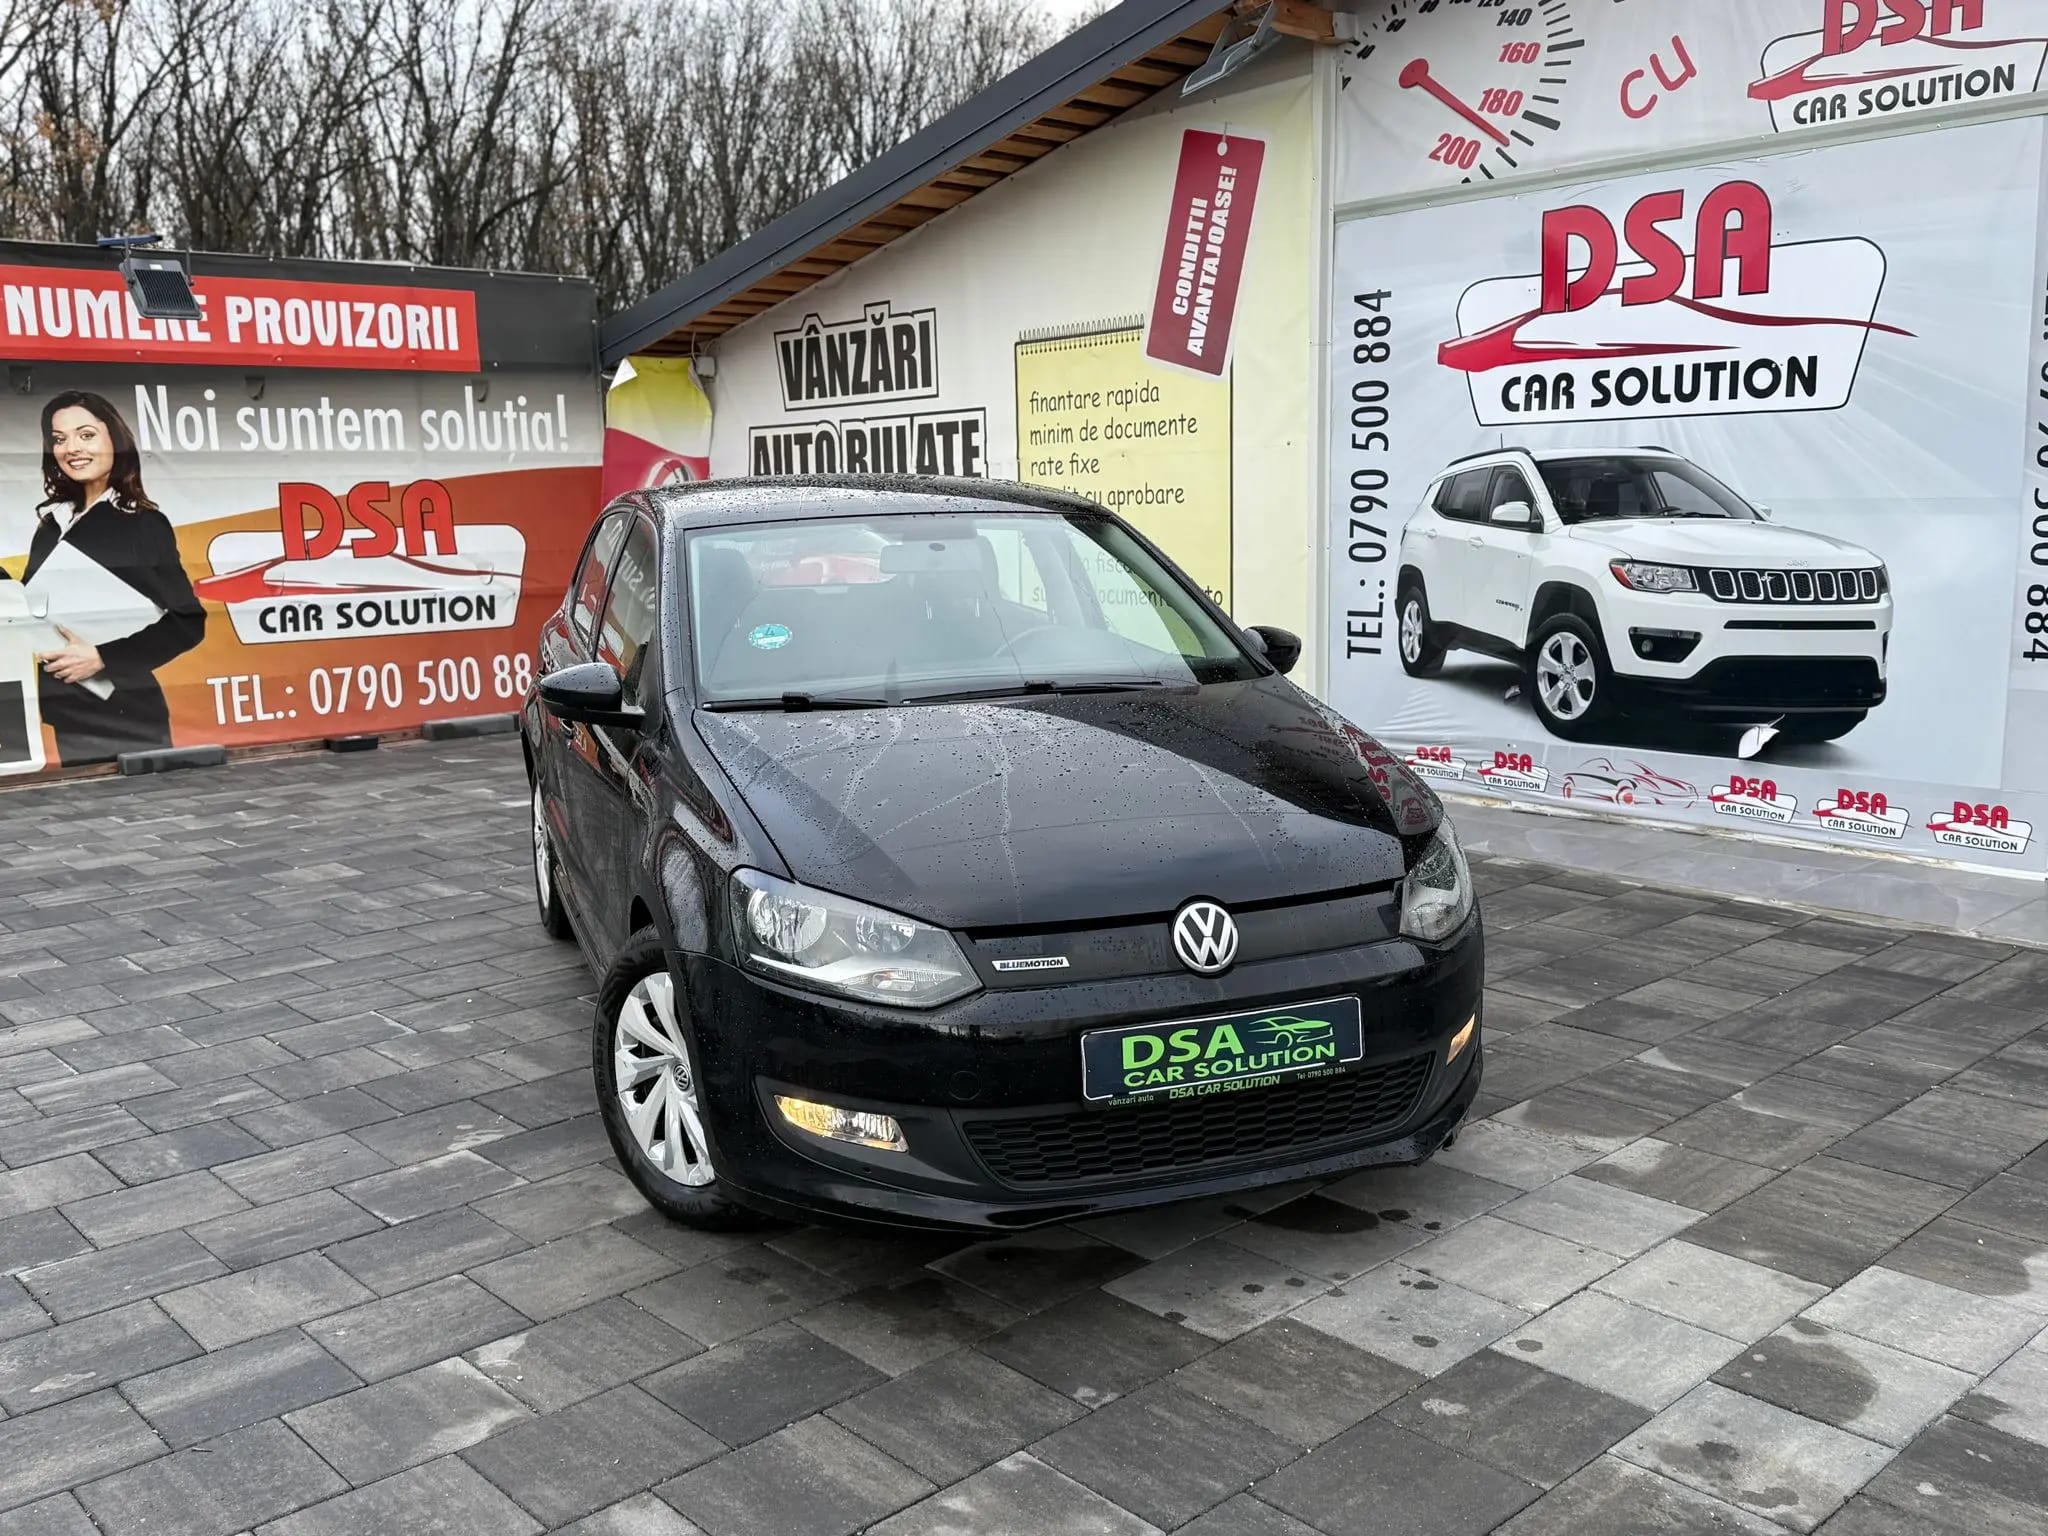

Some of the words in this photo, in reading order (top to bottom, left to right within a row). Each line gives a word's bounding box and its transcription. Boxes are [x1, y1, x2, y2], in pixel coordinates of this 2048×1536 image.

[1496, 8, 1533, 27] 140
[1498, 42, 1541, 64] 160
[1620, 35, 1698, 119] cu
[1793, 94, 1846, 125] CAR
[1858, 64, 2015, 116] SOLUTION
[1477, 88, 1524, 116] 180
[1428, 133, 1481, 170] 200
[1172, 197, 1208, 316] CONDITII
[1187, 165, 1237, 357] AVANTAJOASE!
[1541, 180, 1772, 314] DSA
[225, 295, 459, 352] PROVIZORII
[1354, 289, 1392, 364] 884
[780, 312, 932, 400] VÂNZĂRI
[1030, 391, 1101, 414] finantare
[1107, 379, 1160, 412] rapida
[1501, 372, 1575, 412] CAR
[1591, 355, 1818, 407] SOLUTION
[135, 385, 221, 452] Noi
[236, 397, 406, 452] suntem
[1030, 423, 1074, 446] minim
[1079, 419, 1099, 442] de
[1104, 413, 1198, 440] documente
[1351, 380, 1389, 451] 500
[1031, 457, 1064, 477] rate
[1070, 452, 1100, 476] fixe
[1108, 482, 1185, 512] aprobare
[1349, 468, 1389, 562] 0790
[278, 479, 457, 561] DSA
[259, 604, 323, 633] CAR
[336, 594, 496, 630] SOLUTION
[1347, 579, 1385, 659] TEL.:
[206, 675, 297, 725] TEL.:
[309, 662, 402, 715] 0790
[417, 656, 481, 705] 500
[1416, 747, 1452, 763] DSA
[1494, 752, 1532, 772] DSA
[1427, 768, 1459, 779] SOLUTION
[1488, 777, 1502, 785] CAR
[1504, 778, 1540, 790] SOLUTION
[1730, 775, 1776, 801] DSA
[1720, 803, 1737, 815] CAR
[1739, 805, 1785, 821] SOLUTION
[1836, 788, 1887, 815] DSA
[1952, 801, 2009, 829] DSA
[1827, 818, 1846, 831] CAR
[1848, 821, 1896, 837] SOLUTION
[1942, 832, 1962, 845] CAR
[1965, 835, 2018, 852] SOLUTION
[1000, 958, 1064, 969] BLUEMOTION
[1121, 1023, 1244, 1071] DSA
[1123, 1065, 1185, 1087] CAR
[1194, 1042, 1336, 1078] SOLUTION
[1137, 1094, 1154, 1103] auto
[1169, 1086, 1195, 1100] DSA
[1197, 1082, 1222, 1096] CAR
[1223, 1075, 1281, 1094] SOLUTION
